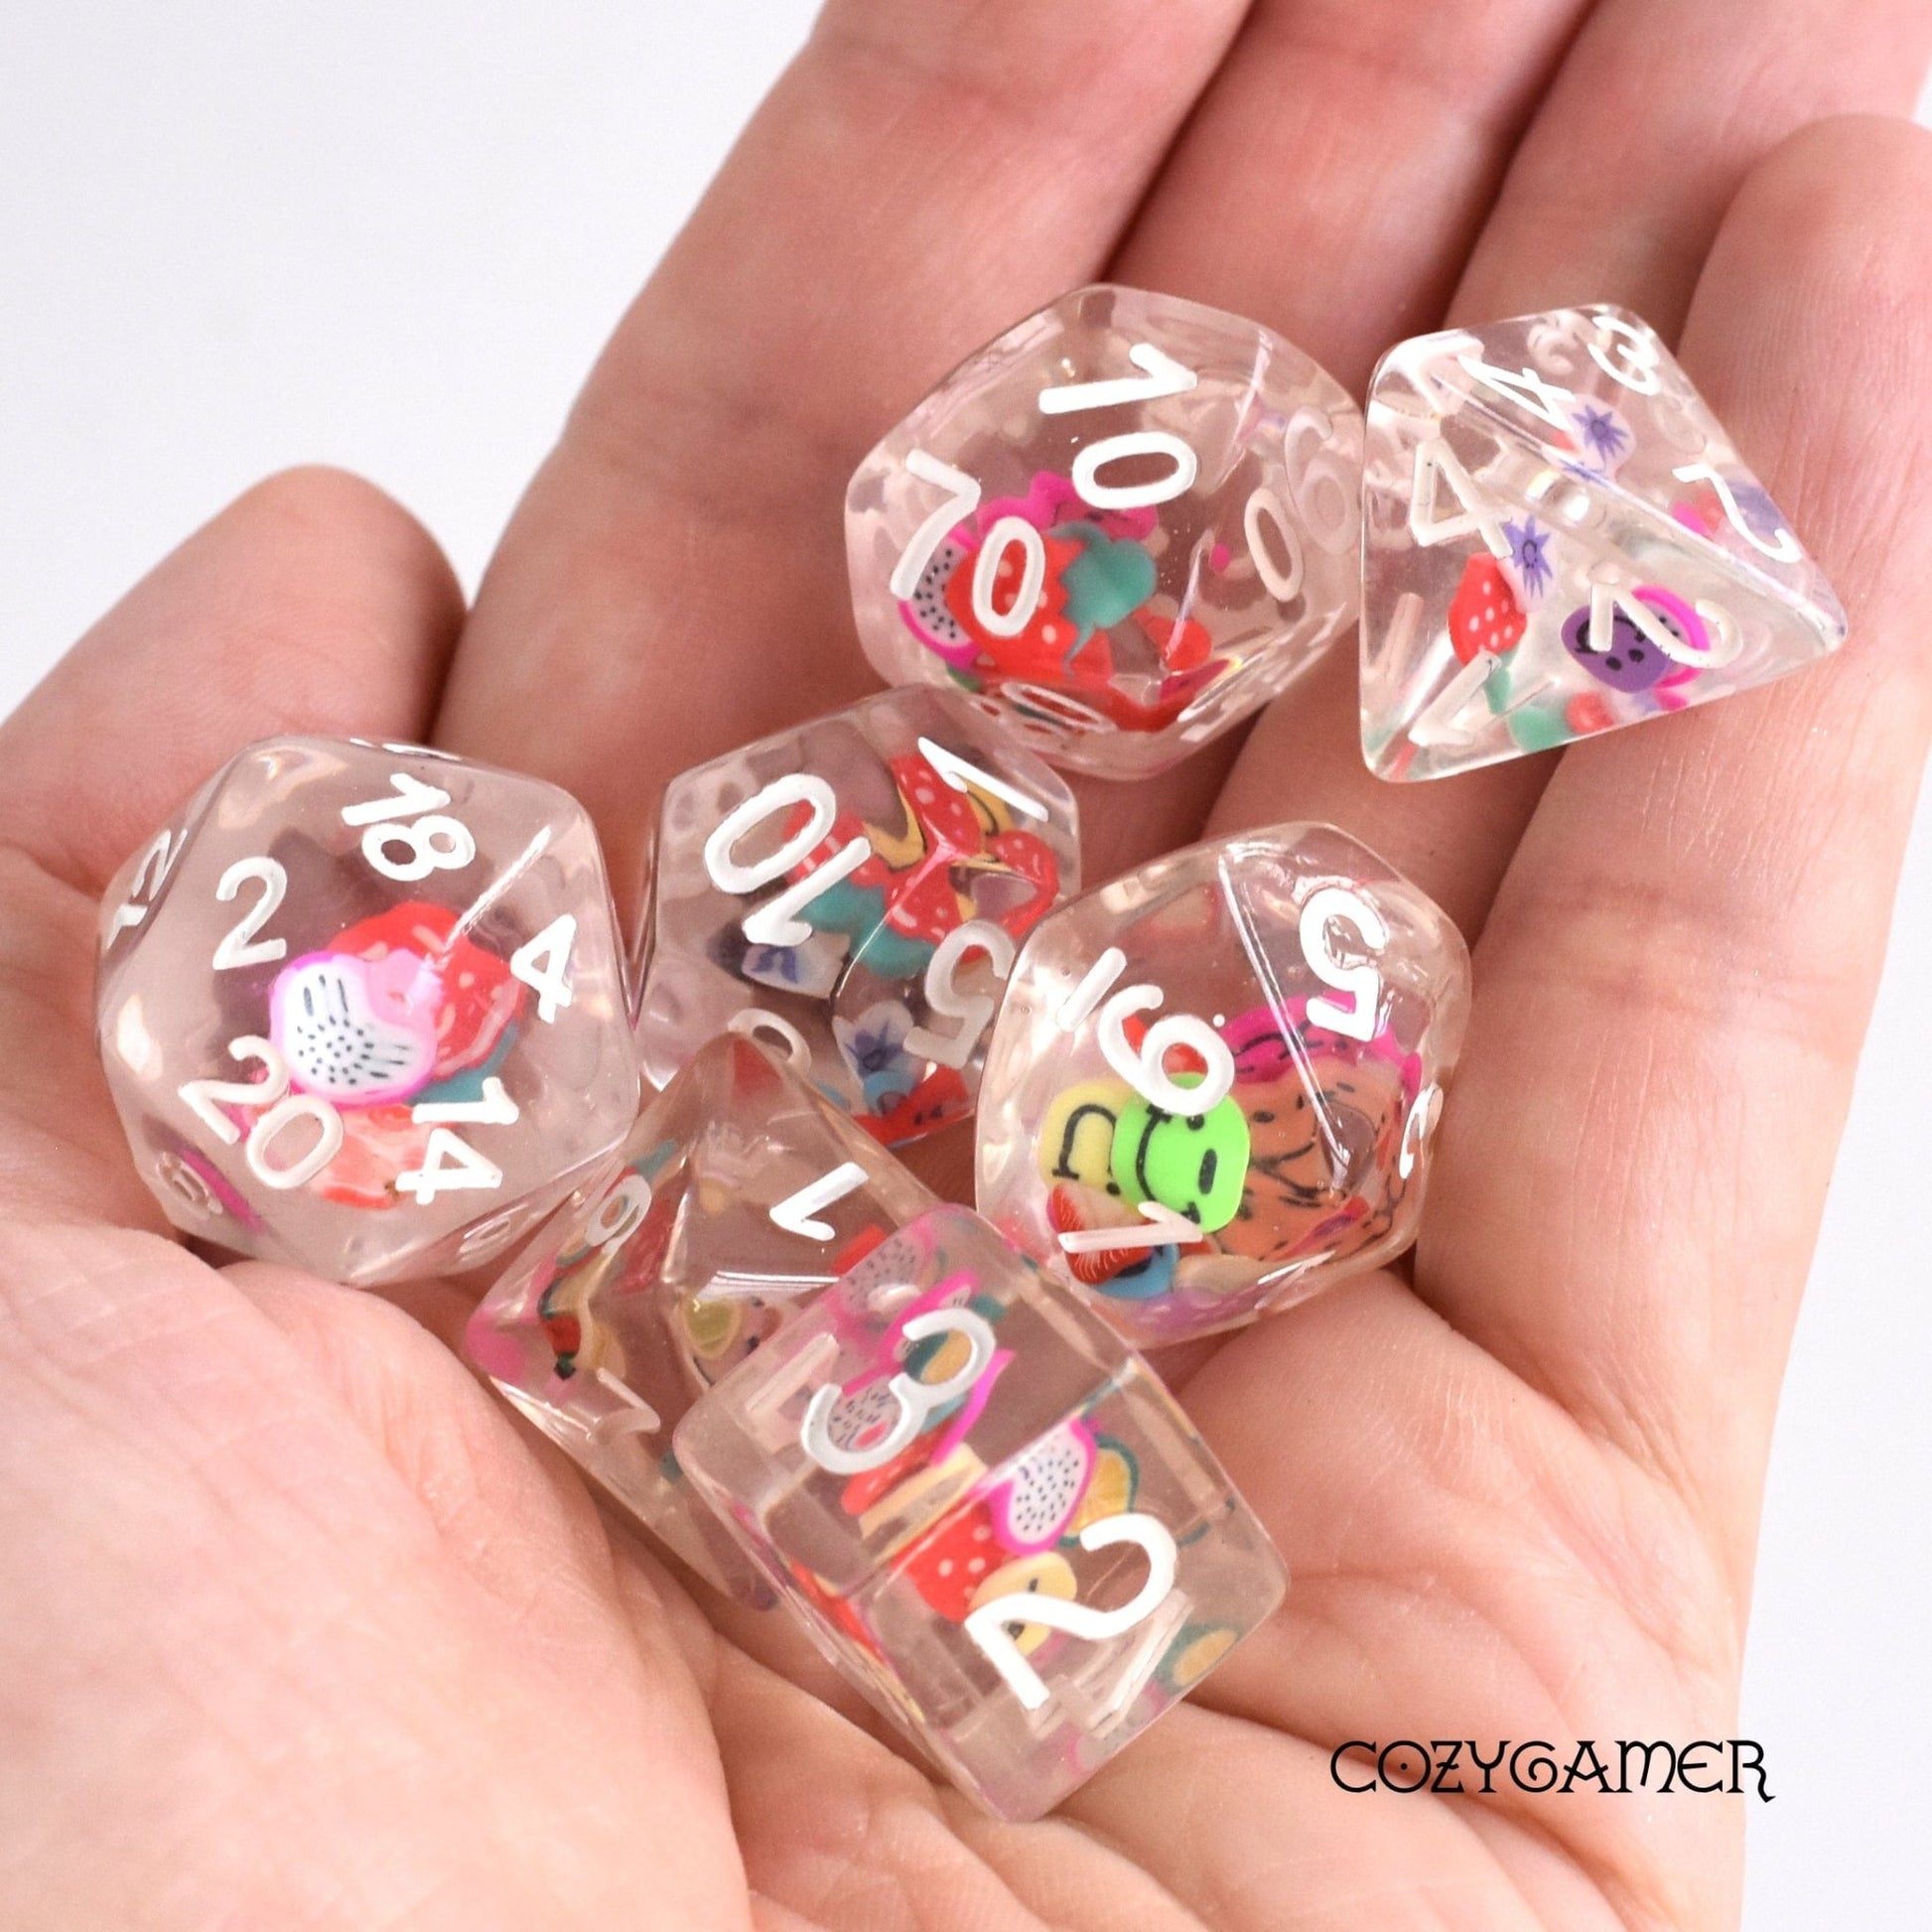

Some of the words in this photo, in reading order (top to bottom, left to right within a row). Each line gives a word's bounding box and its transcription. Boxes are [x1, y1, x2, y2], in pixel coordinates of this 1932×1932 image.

[1456, 354, 1577, 433] 4
[1587, 315, 1662, 396] 3
[1038, 343, 1198, 509] 10
[889, 448, 1046, 637] 70
[1409, 437, 1515, 560] 4
[1672, 463, 1803, 564] 2
[1588, 583, 1743, 669] 2
[341, 772, 478, 882] 18
[917, 736, 1050, 822] 1
[211, 856, 289, 971] 2
[704, 772, 872, 947] 10
[509, 913, 578, 1026] 4
[902, 919, 1018, 1070] 5
[1299, 887, 1389, 1042] 5
[177, 1035, 345, 1190] 20
[395, 1075, 520, 1205] 14
[1057, 1200, 1203, 1254] 1
[800, 1307, 998, 1475] 3
[964, 1512, 1178, 1710] 2
